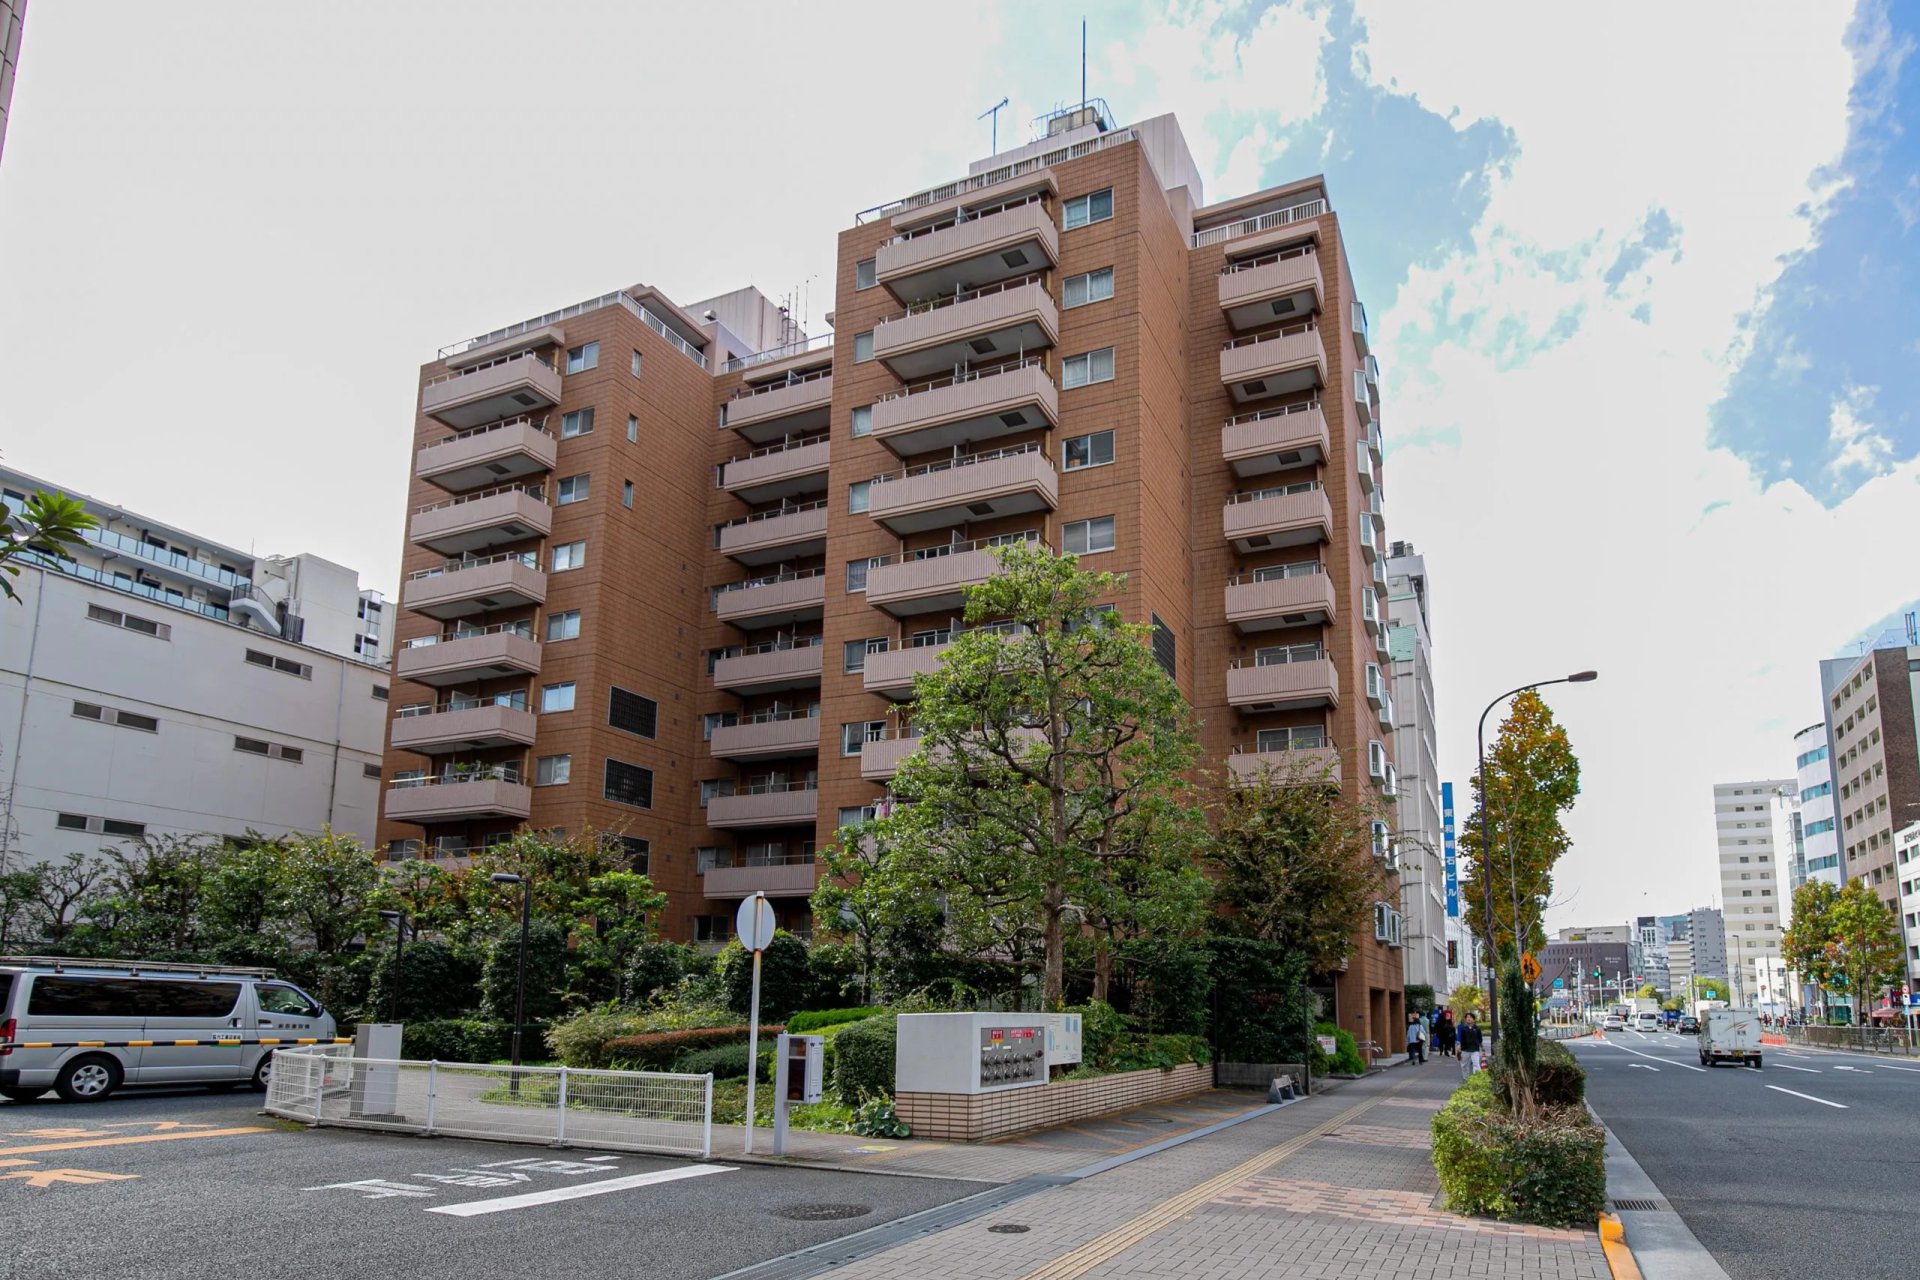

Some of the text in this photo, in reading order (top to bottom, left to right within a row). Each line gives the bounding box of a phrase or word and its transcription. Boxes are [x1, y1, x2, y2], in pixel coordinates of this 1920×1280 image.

[1444, 809, 1456, 897] 東和明石ビル
